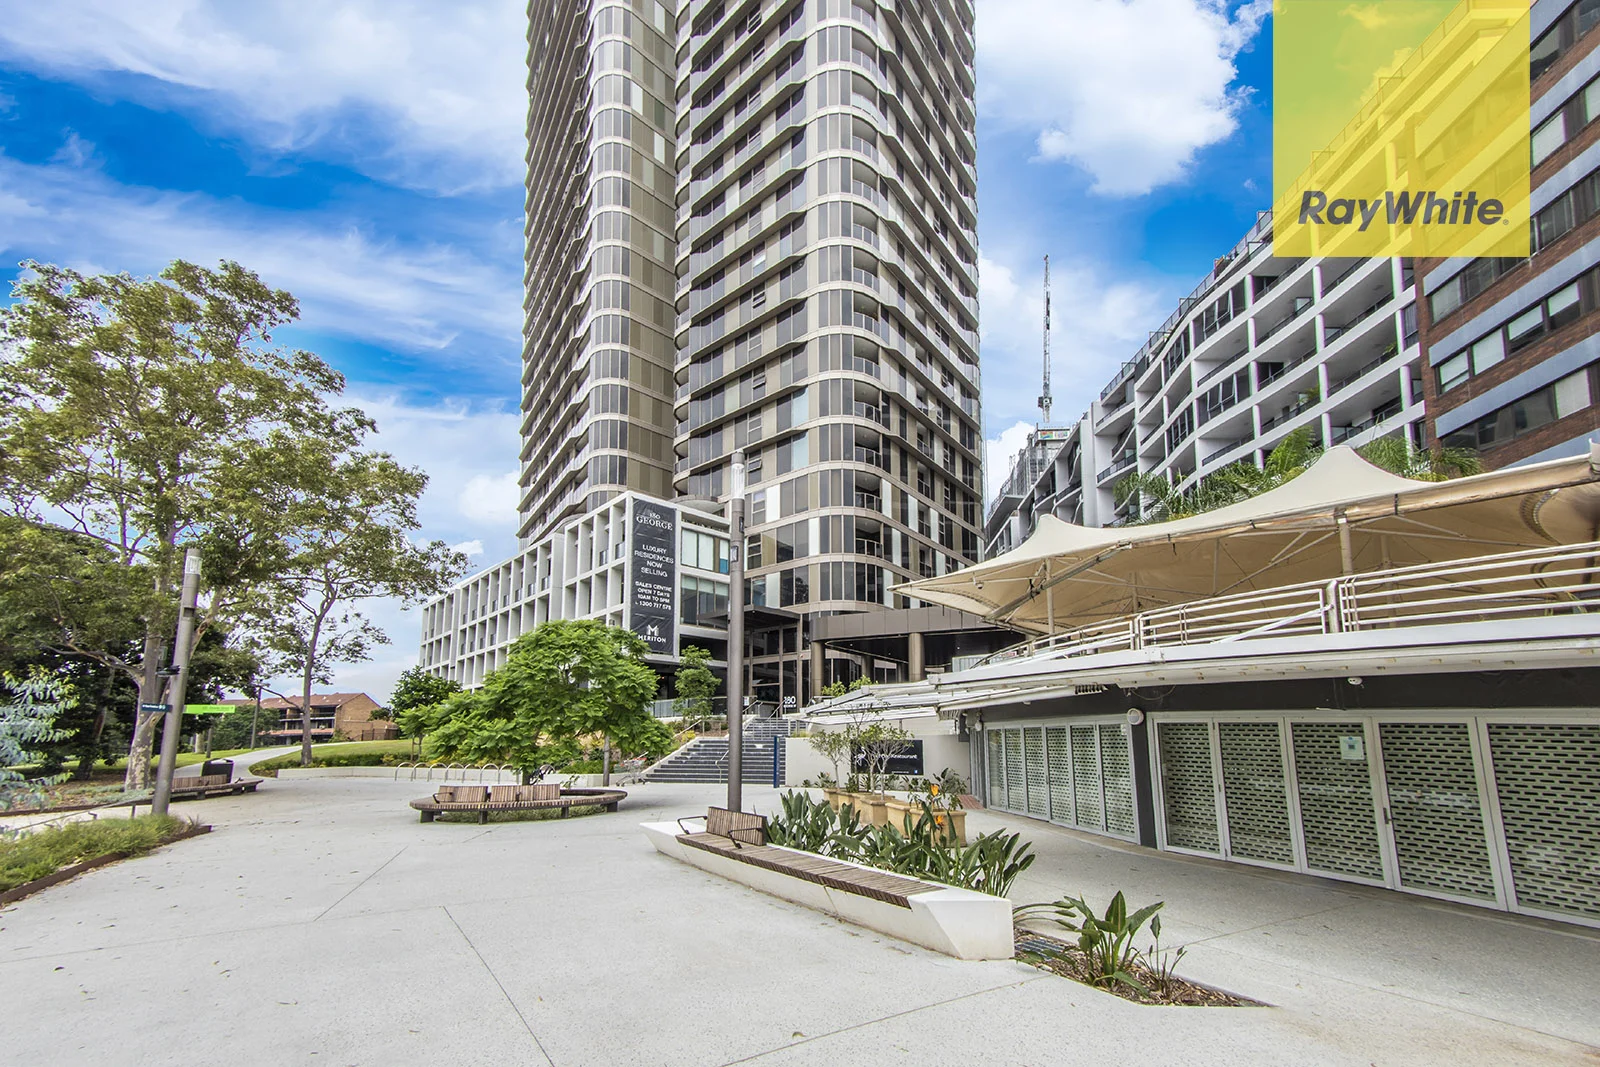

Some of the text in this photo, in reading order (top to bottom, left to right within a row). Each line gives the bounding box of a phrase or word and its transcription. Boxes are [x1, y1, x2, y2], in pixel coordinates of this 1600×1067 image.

[636, 514, 673, 531] GEORGE
[642, 544, 667, 554] LUXURY
[634, 550, 674, 564] RESIDENCES
[646, 560, 663, 569] NOW
[640, 566, 668, 578] SELLING
[635, 581, 672, 593] SALES CENTRE
[637, 587, 652, 595] OPEN
[656, 590, 671, 598] DAYS
[637, 593, 652, 601] 10AM
[639, 600, 653, 608] 1300
[637, 634, 667, 644] MERITON
